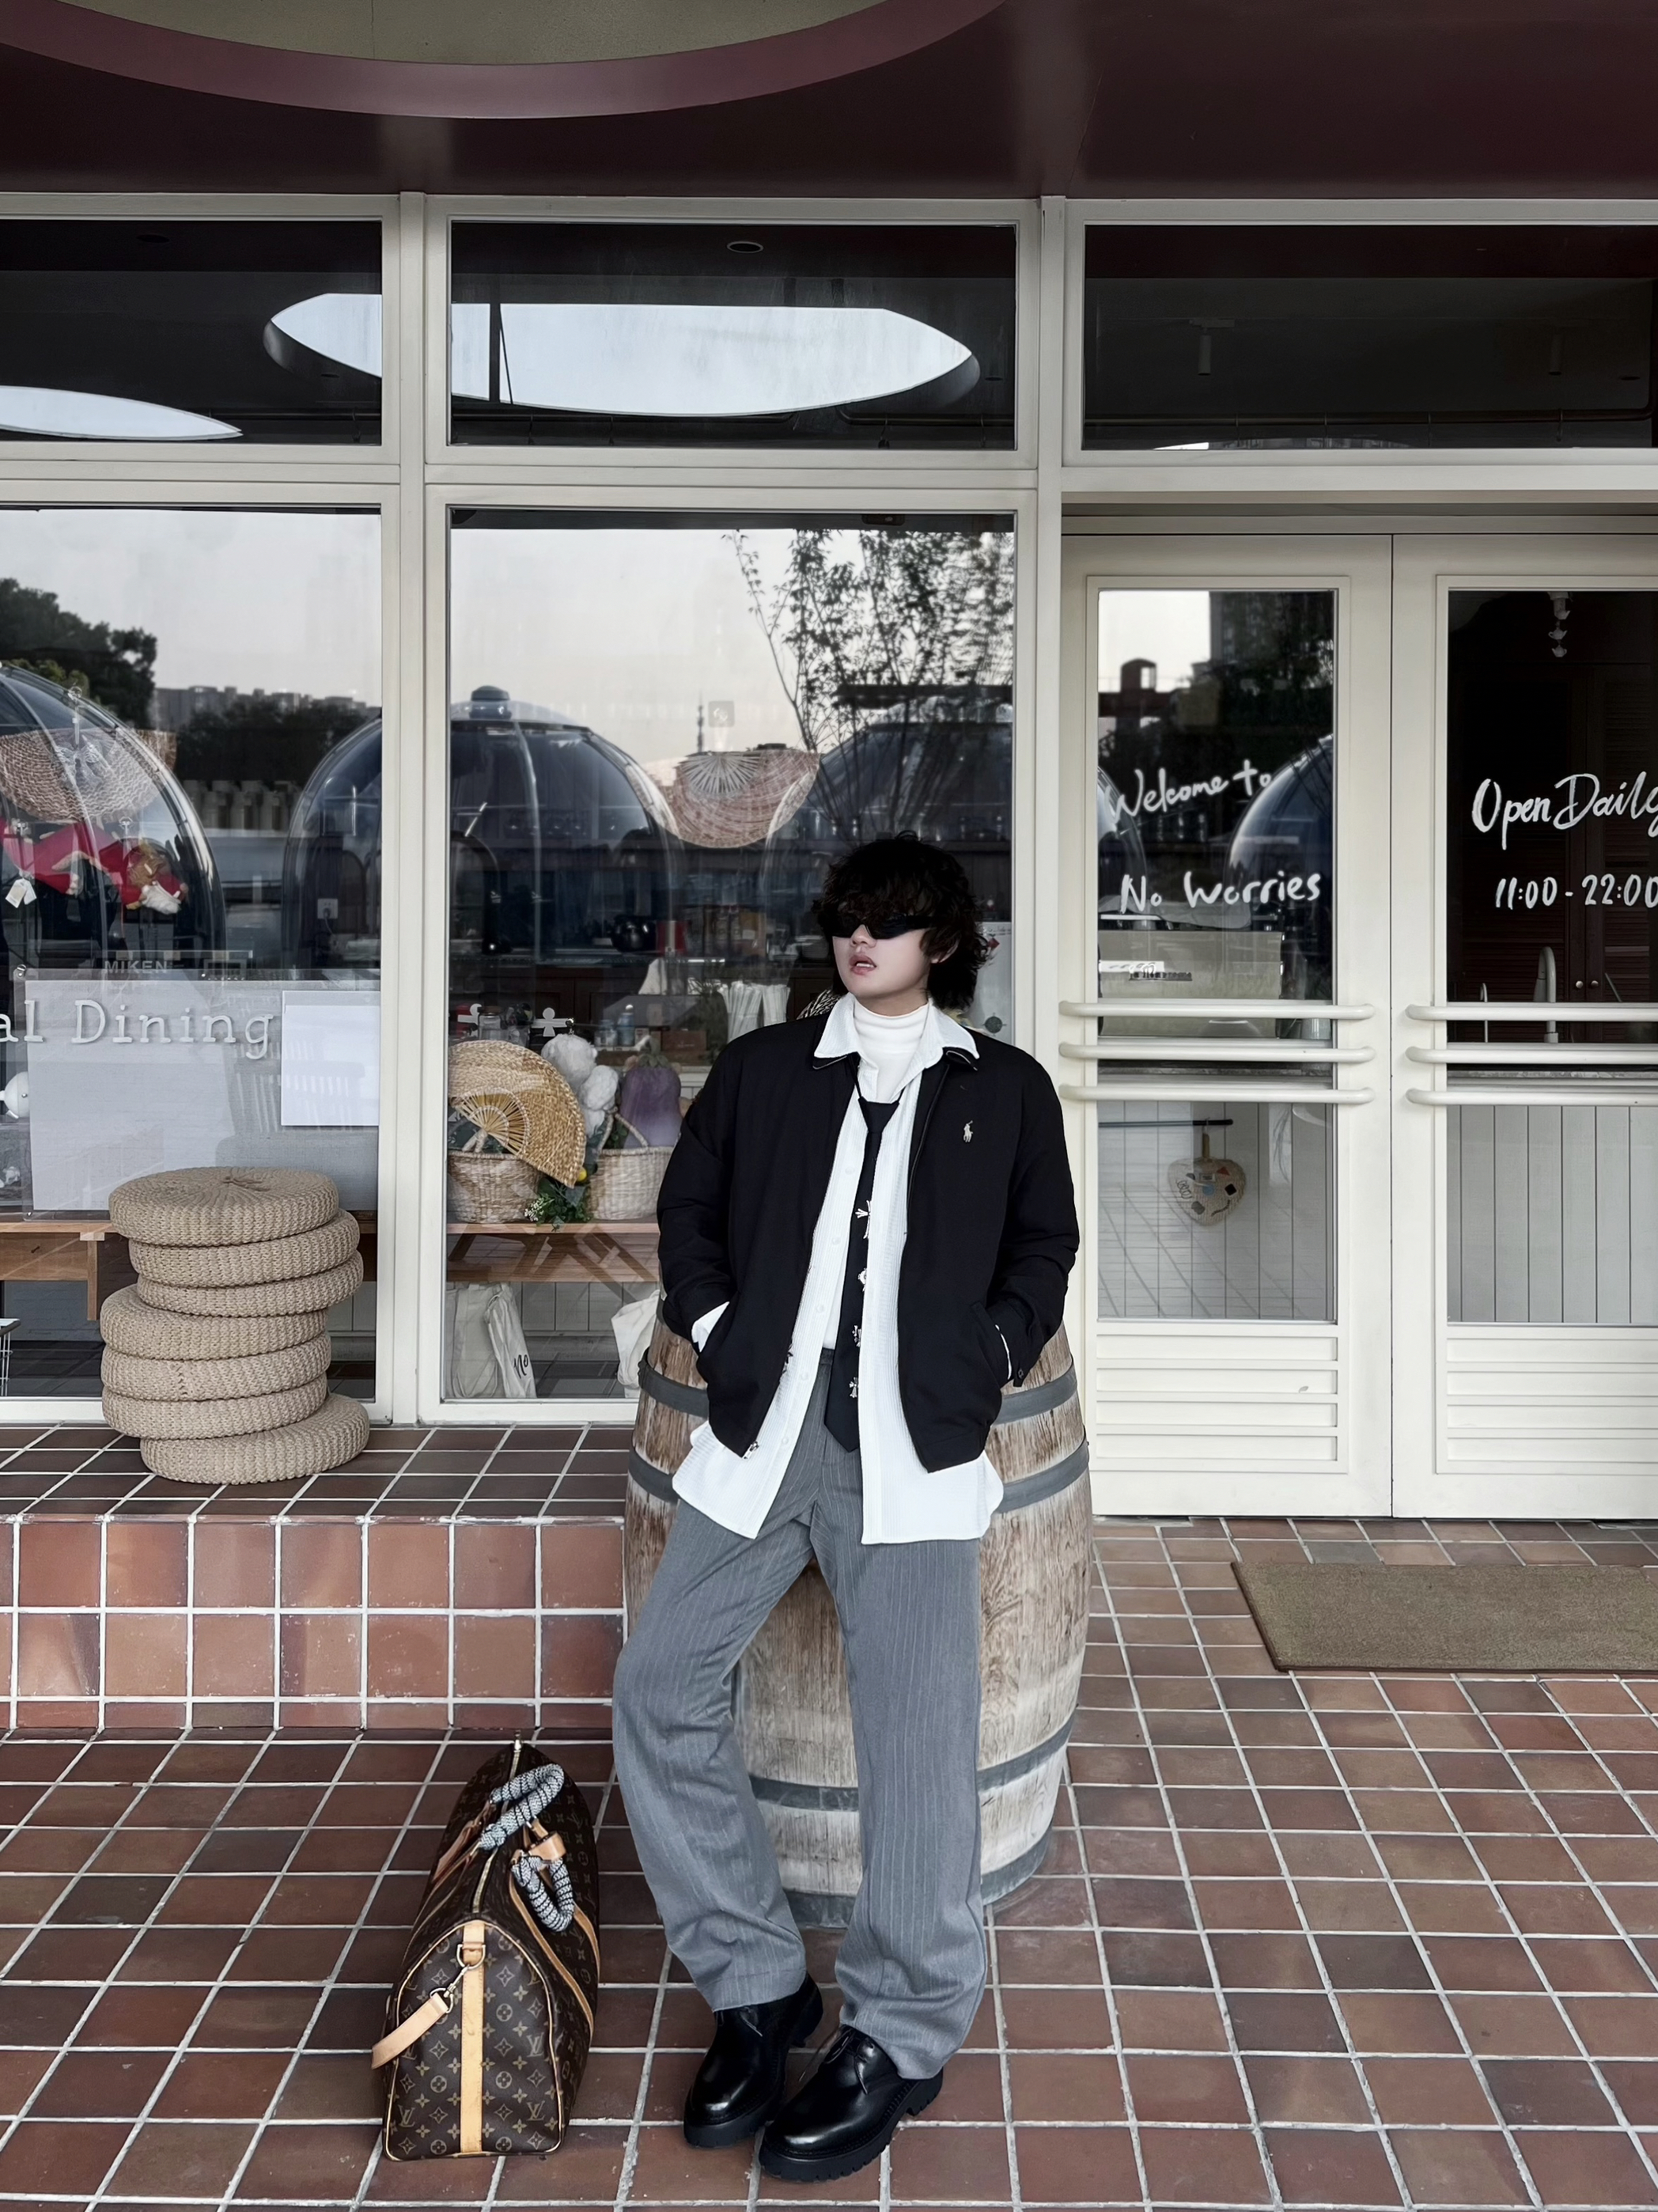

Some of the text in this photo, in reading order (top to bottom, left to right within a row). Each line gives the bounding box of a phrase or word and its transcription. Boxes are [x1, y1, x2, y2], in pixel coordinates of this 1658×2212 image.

[1105, 759, 1274, 824] Welcome to
[1471, 778, 1552, 850] Open
[1120, 873, 1163, 915] No
[1495, 877, 1558, 911] 11:00
[1581, 873, 1658, 908] 22:00
[70, 999, 274, 1060] Dining
